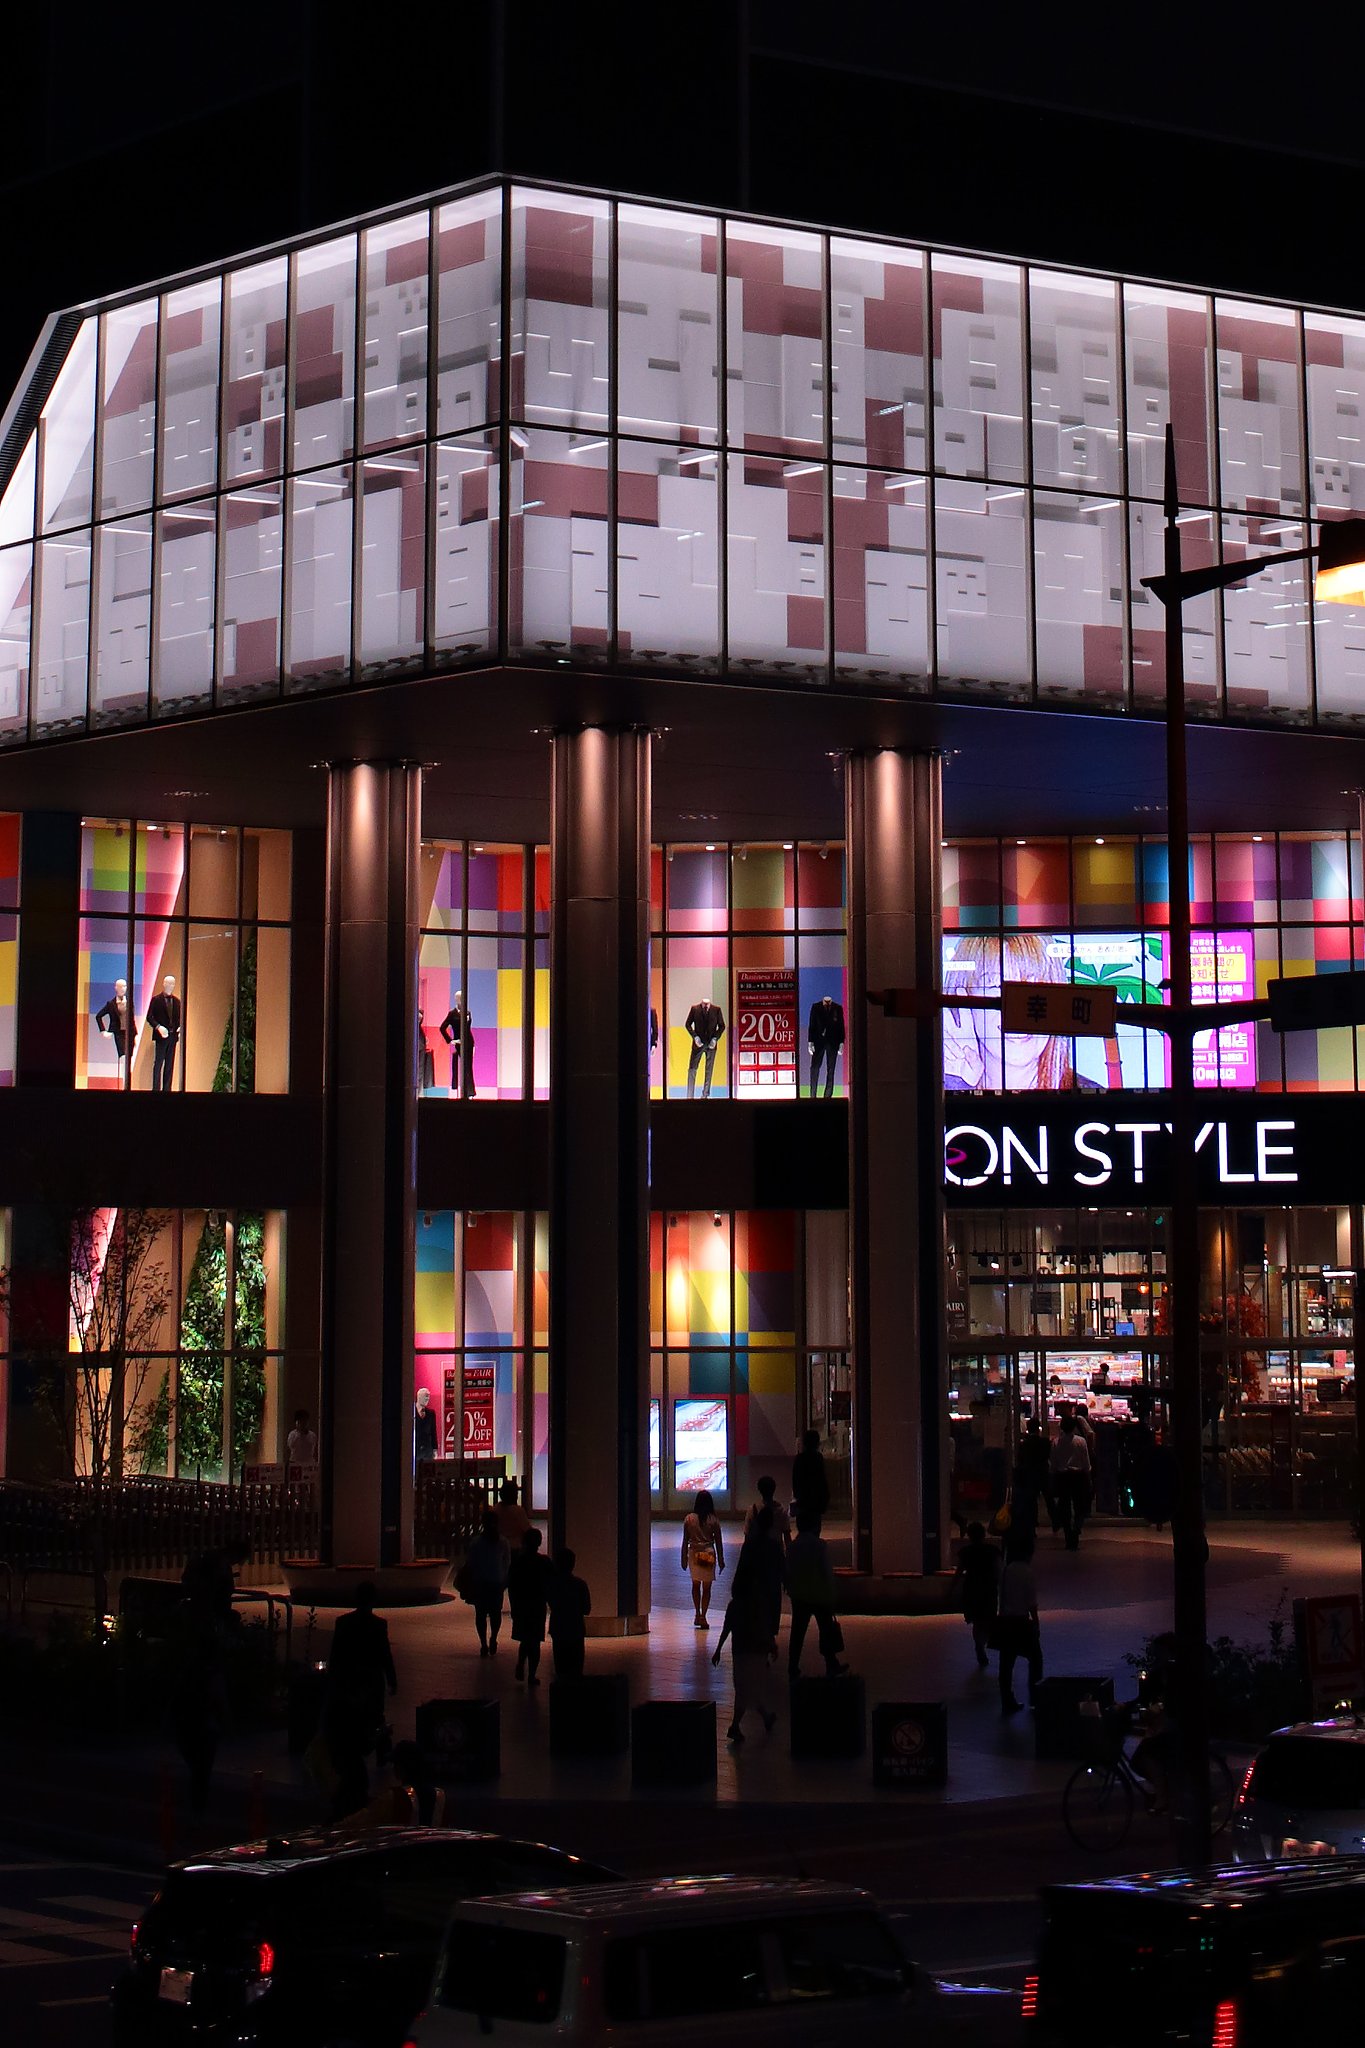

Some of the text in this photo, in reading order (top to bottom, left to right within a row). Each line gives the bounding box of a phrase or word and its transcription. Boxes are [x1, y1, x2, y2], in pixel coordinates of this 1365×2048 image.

[773, 972, 794, 980] FAIR
[1027, 995, 1091, 1024] 幸町
[774, 1030, 795, 1042] OFF
[474, 1429, 492, 1441] OFF
